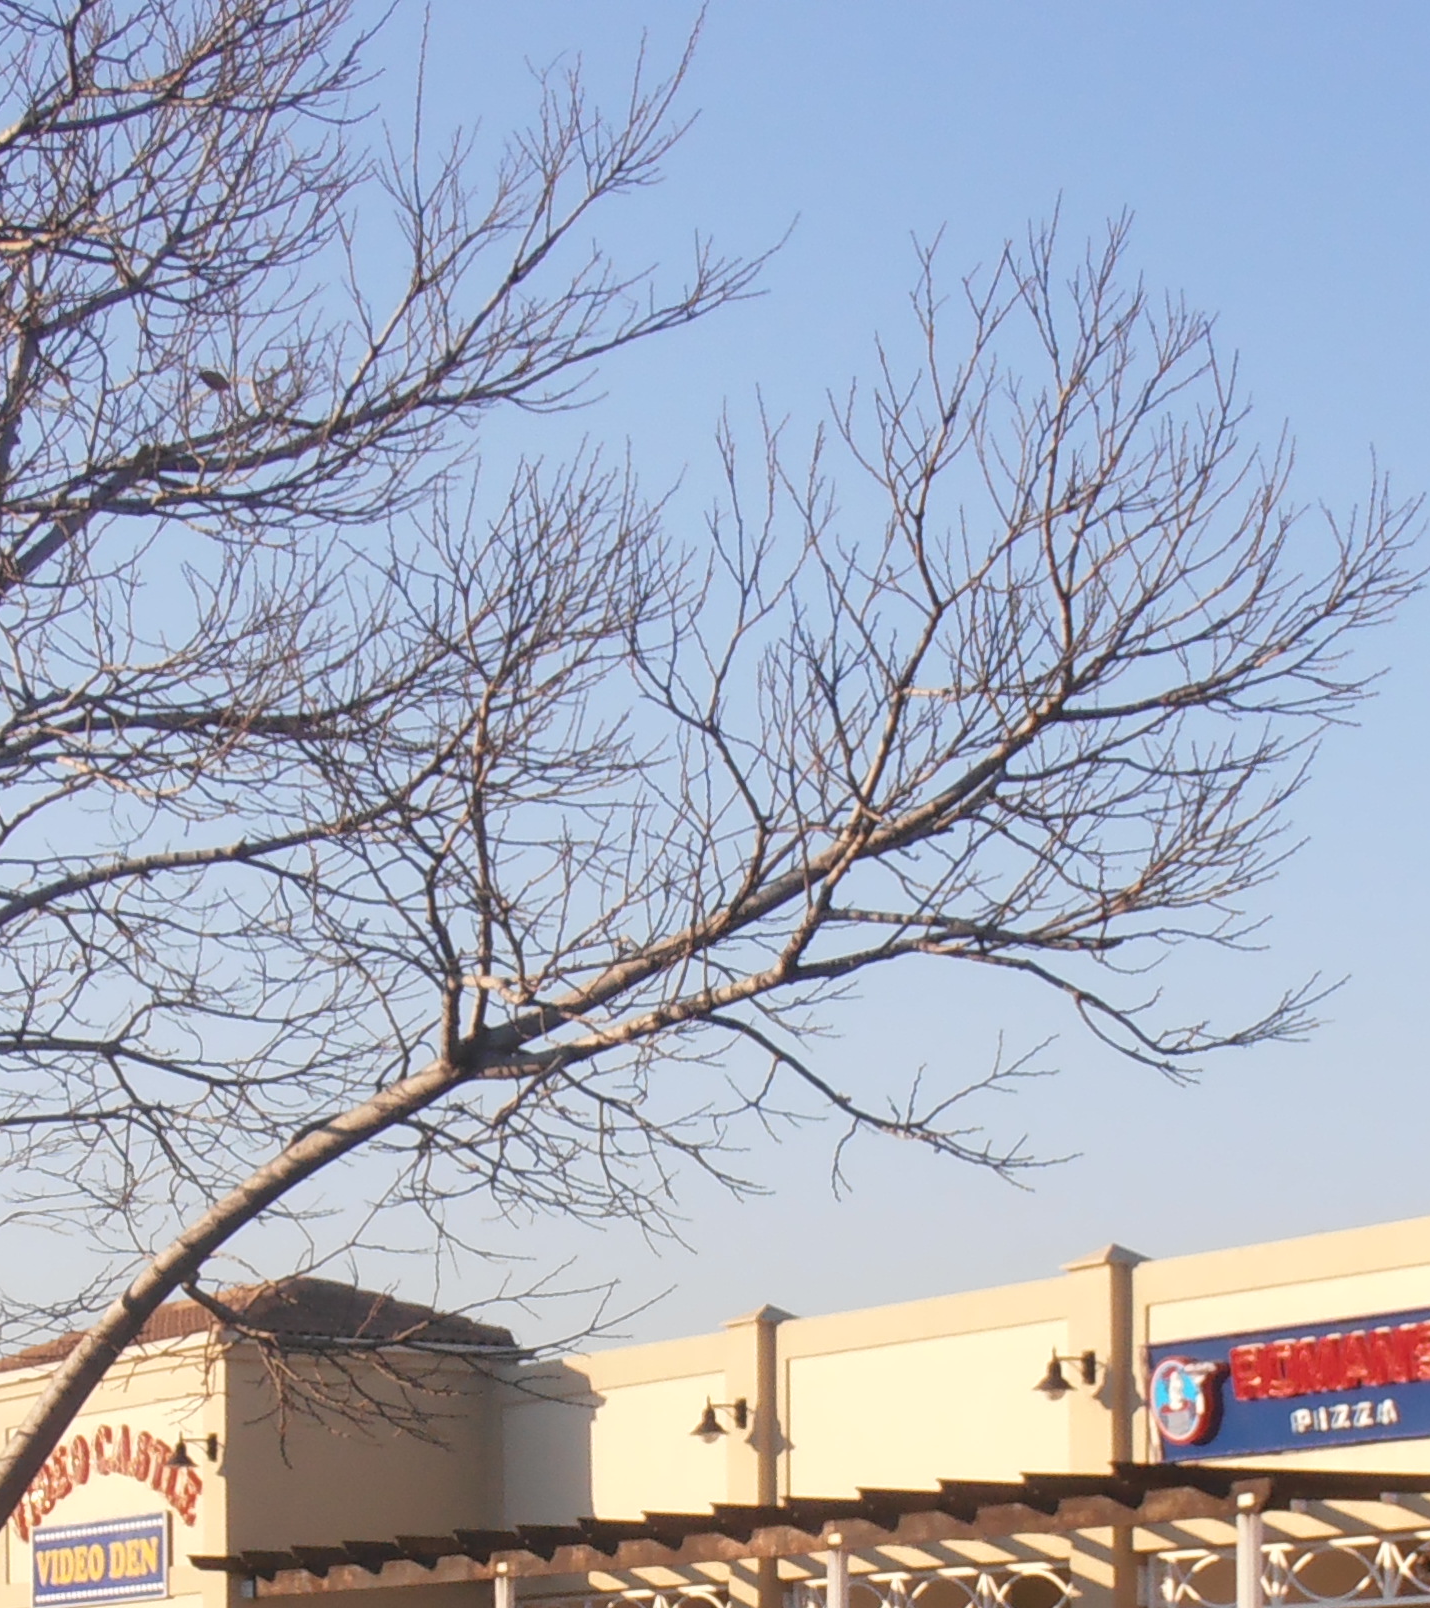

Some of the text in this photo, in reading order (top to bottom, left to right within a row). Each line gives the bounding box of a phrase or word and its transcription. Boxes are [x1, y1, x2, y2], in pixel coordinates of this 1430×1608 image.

[1290, 1398, 1399, 1434] PIZZA
[94, 1423, 203, 1527] CASTLE
[35, 1536, 159, 1588] VIDEO DEN
